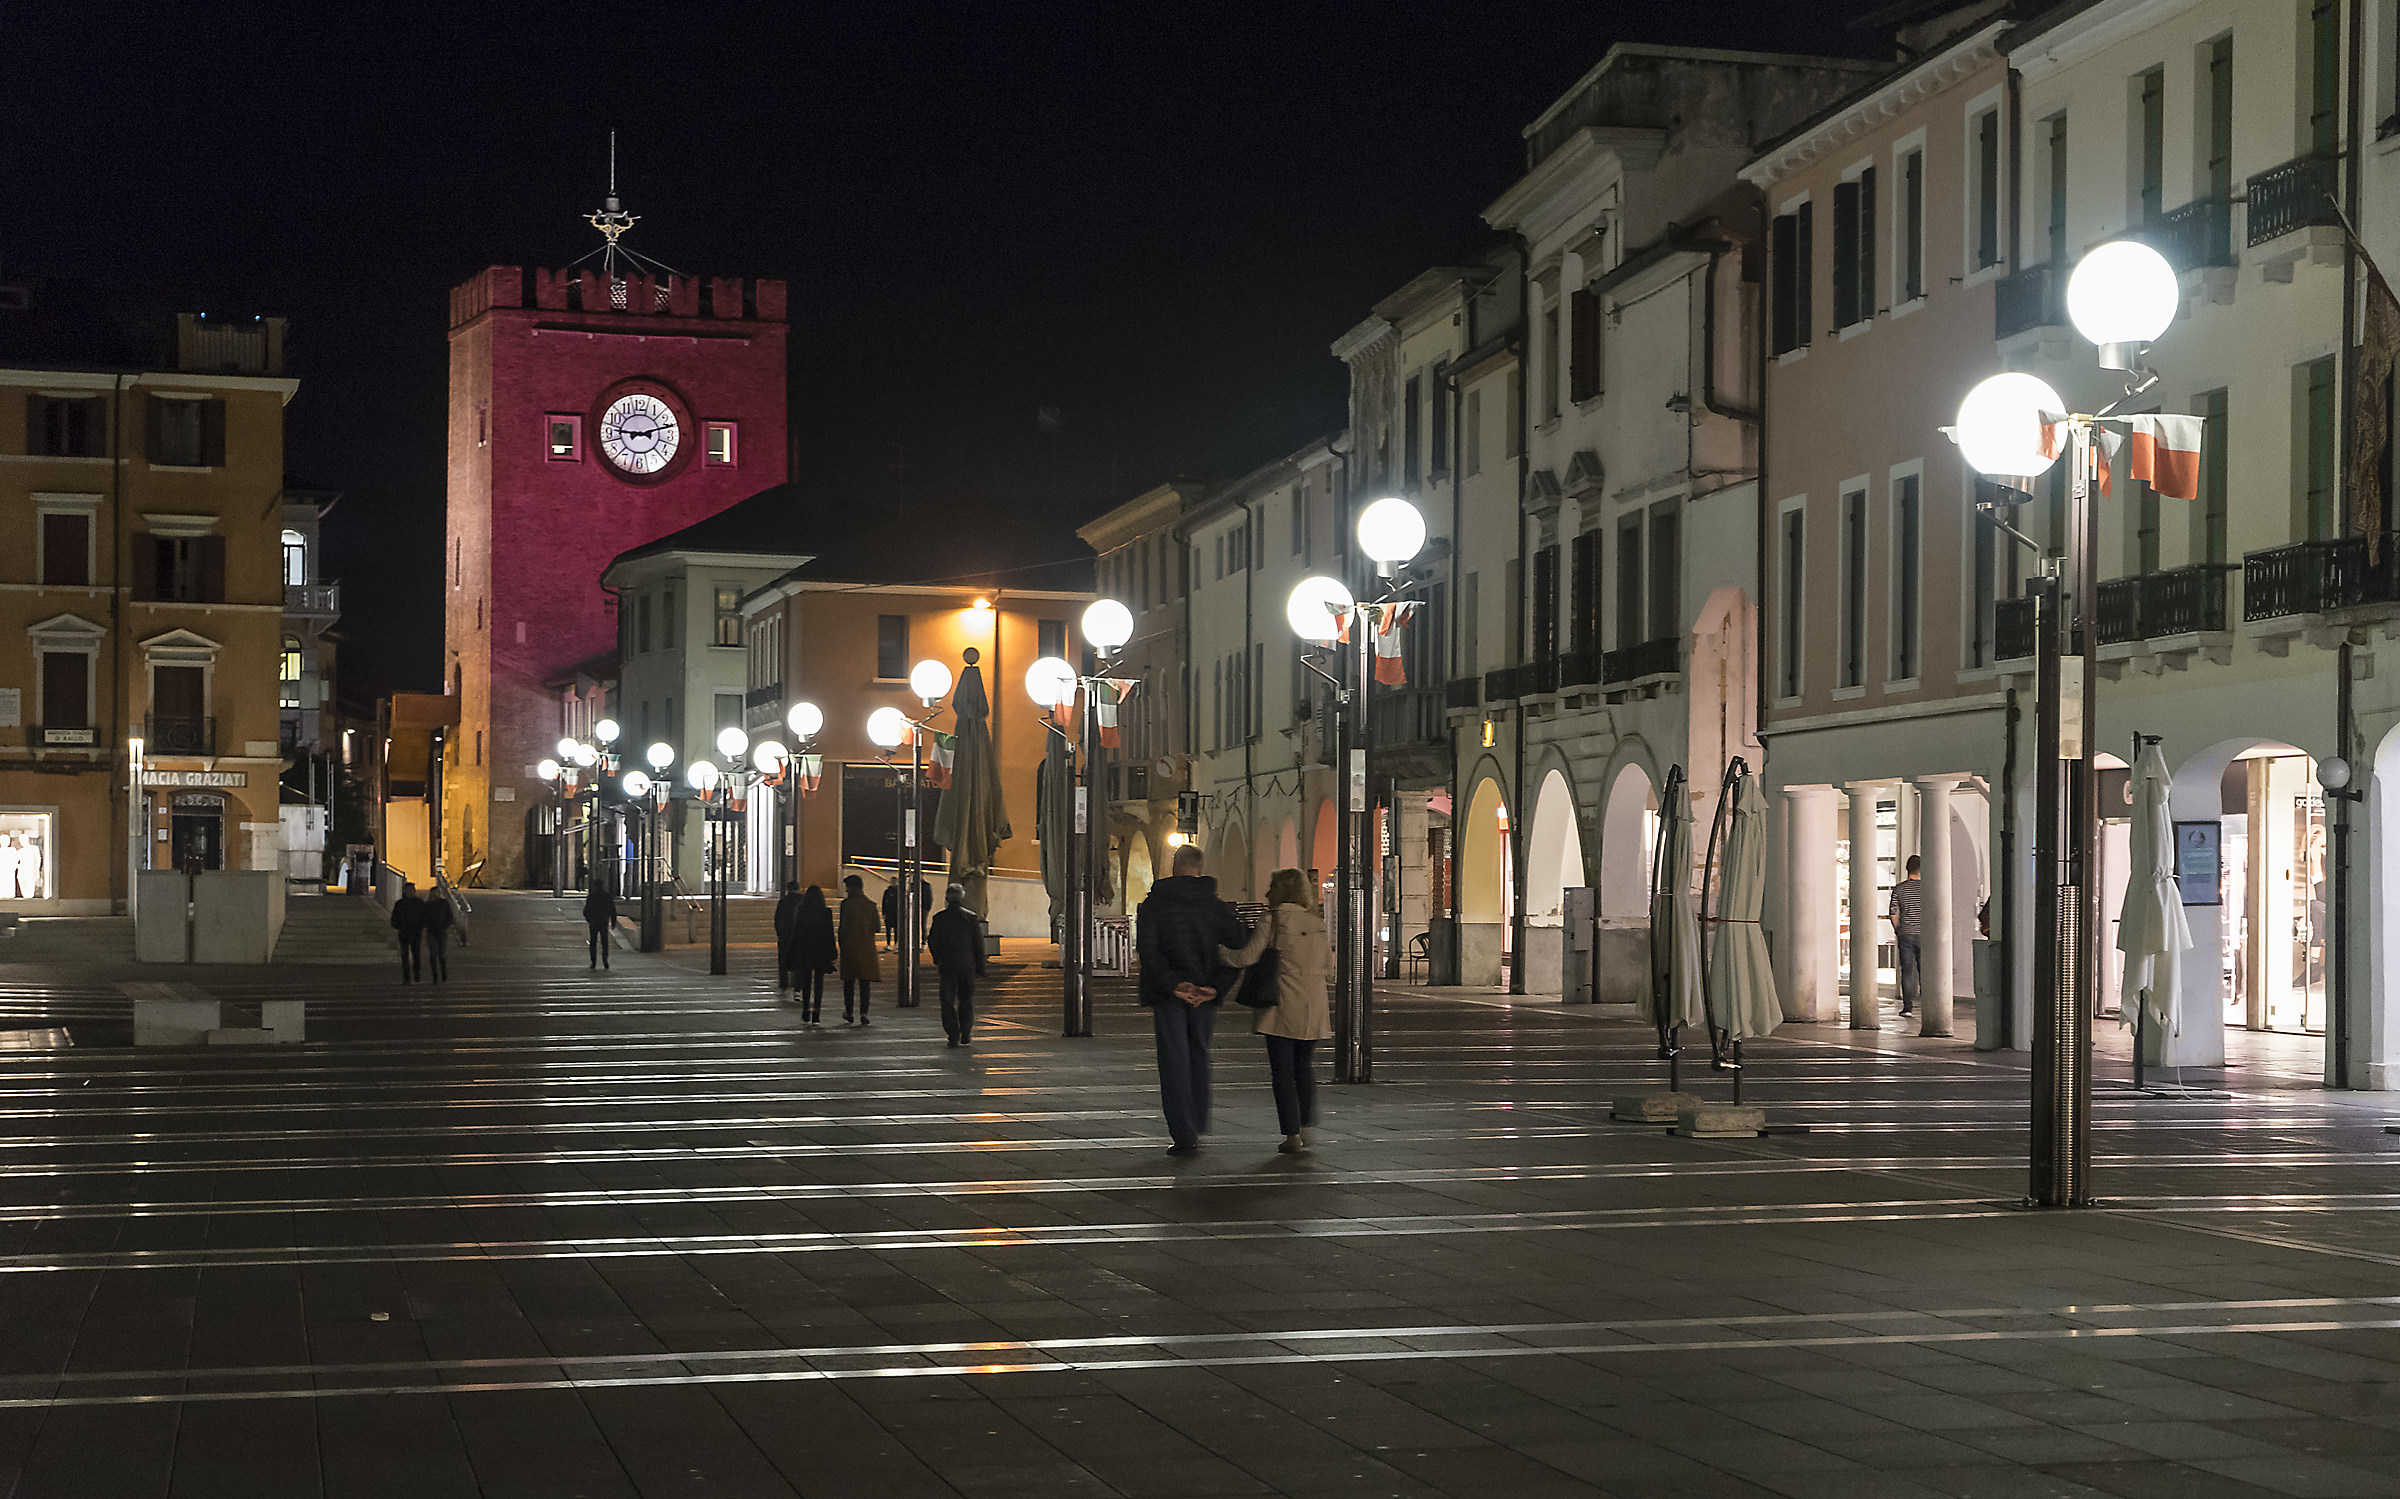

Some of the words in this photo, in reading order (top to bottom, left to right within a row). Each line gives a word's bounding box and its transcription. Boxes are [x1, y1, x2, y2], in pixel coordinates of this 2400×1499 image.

[622, 403, 631, 415] 11
[635, 400, 645, 411] 12
[610, 413, 621, 424] 10
[661, 414, 668, 426] 2
[605, 427, 612, 439] 9
[667, 430, 674, 441] 3
[611, 443, 617, 455] 8
[661, 444, 668, 456] 4
[622, 453, 628, 465] 7
[636, 458, 643, 470] 6
[651, 454, 658, 466] 5
[142, 771, 180, 785] MACIA
[186, 773, 245, 786] GRAZIATI
